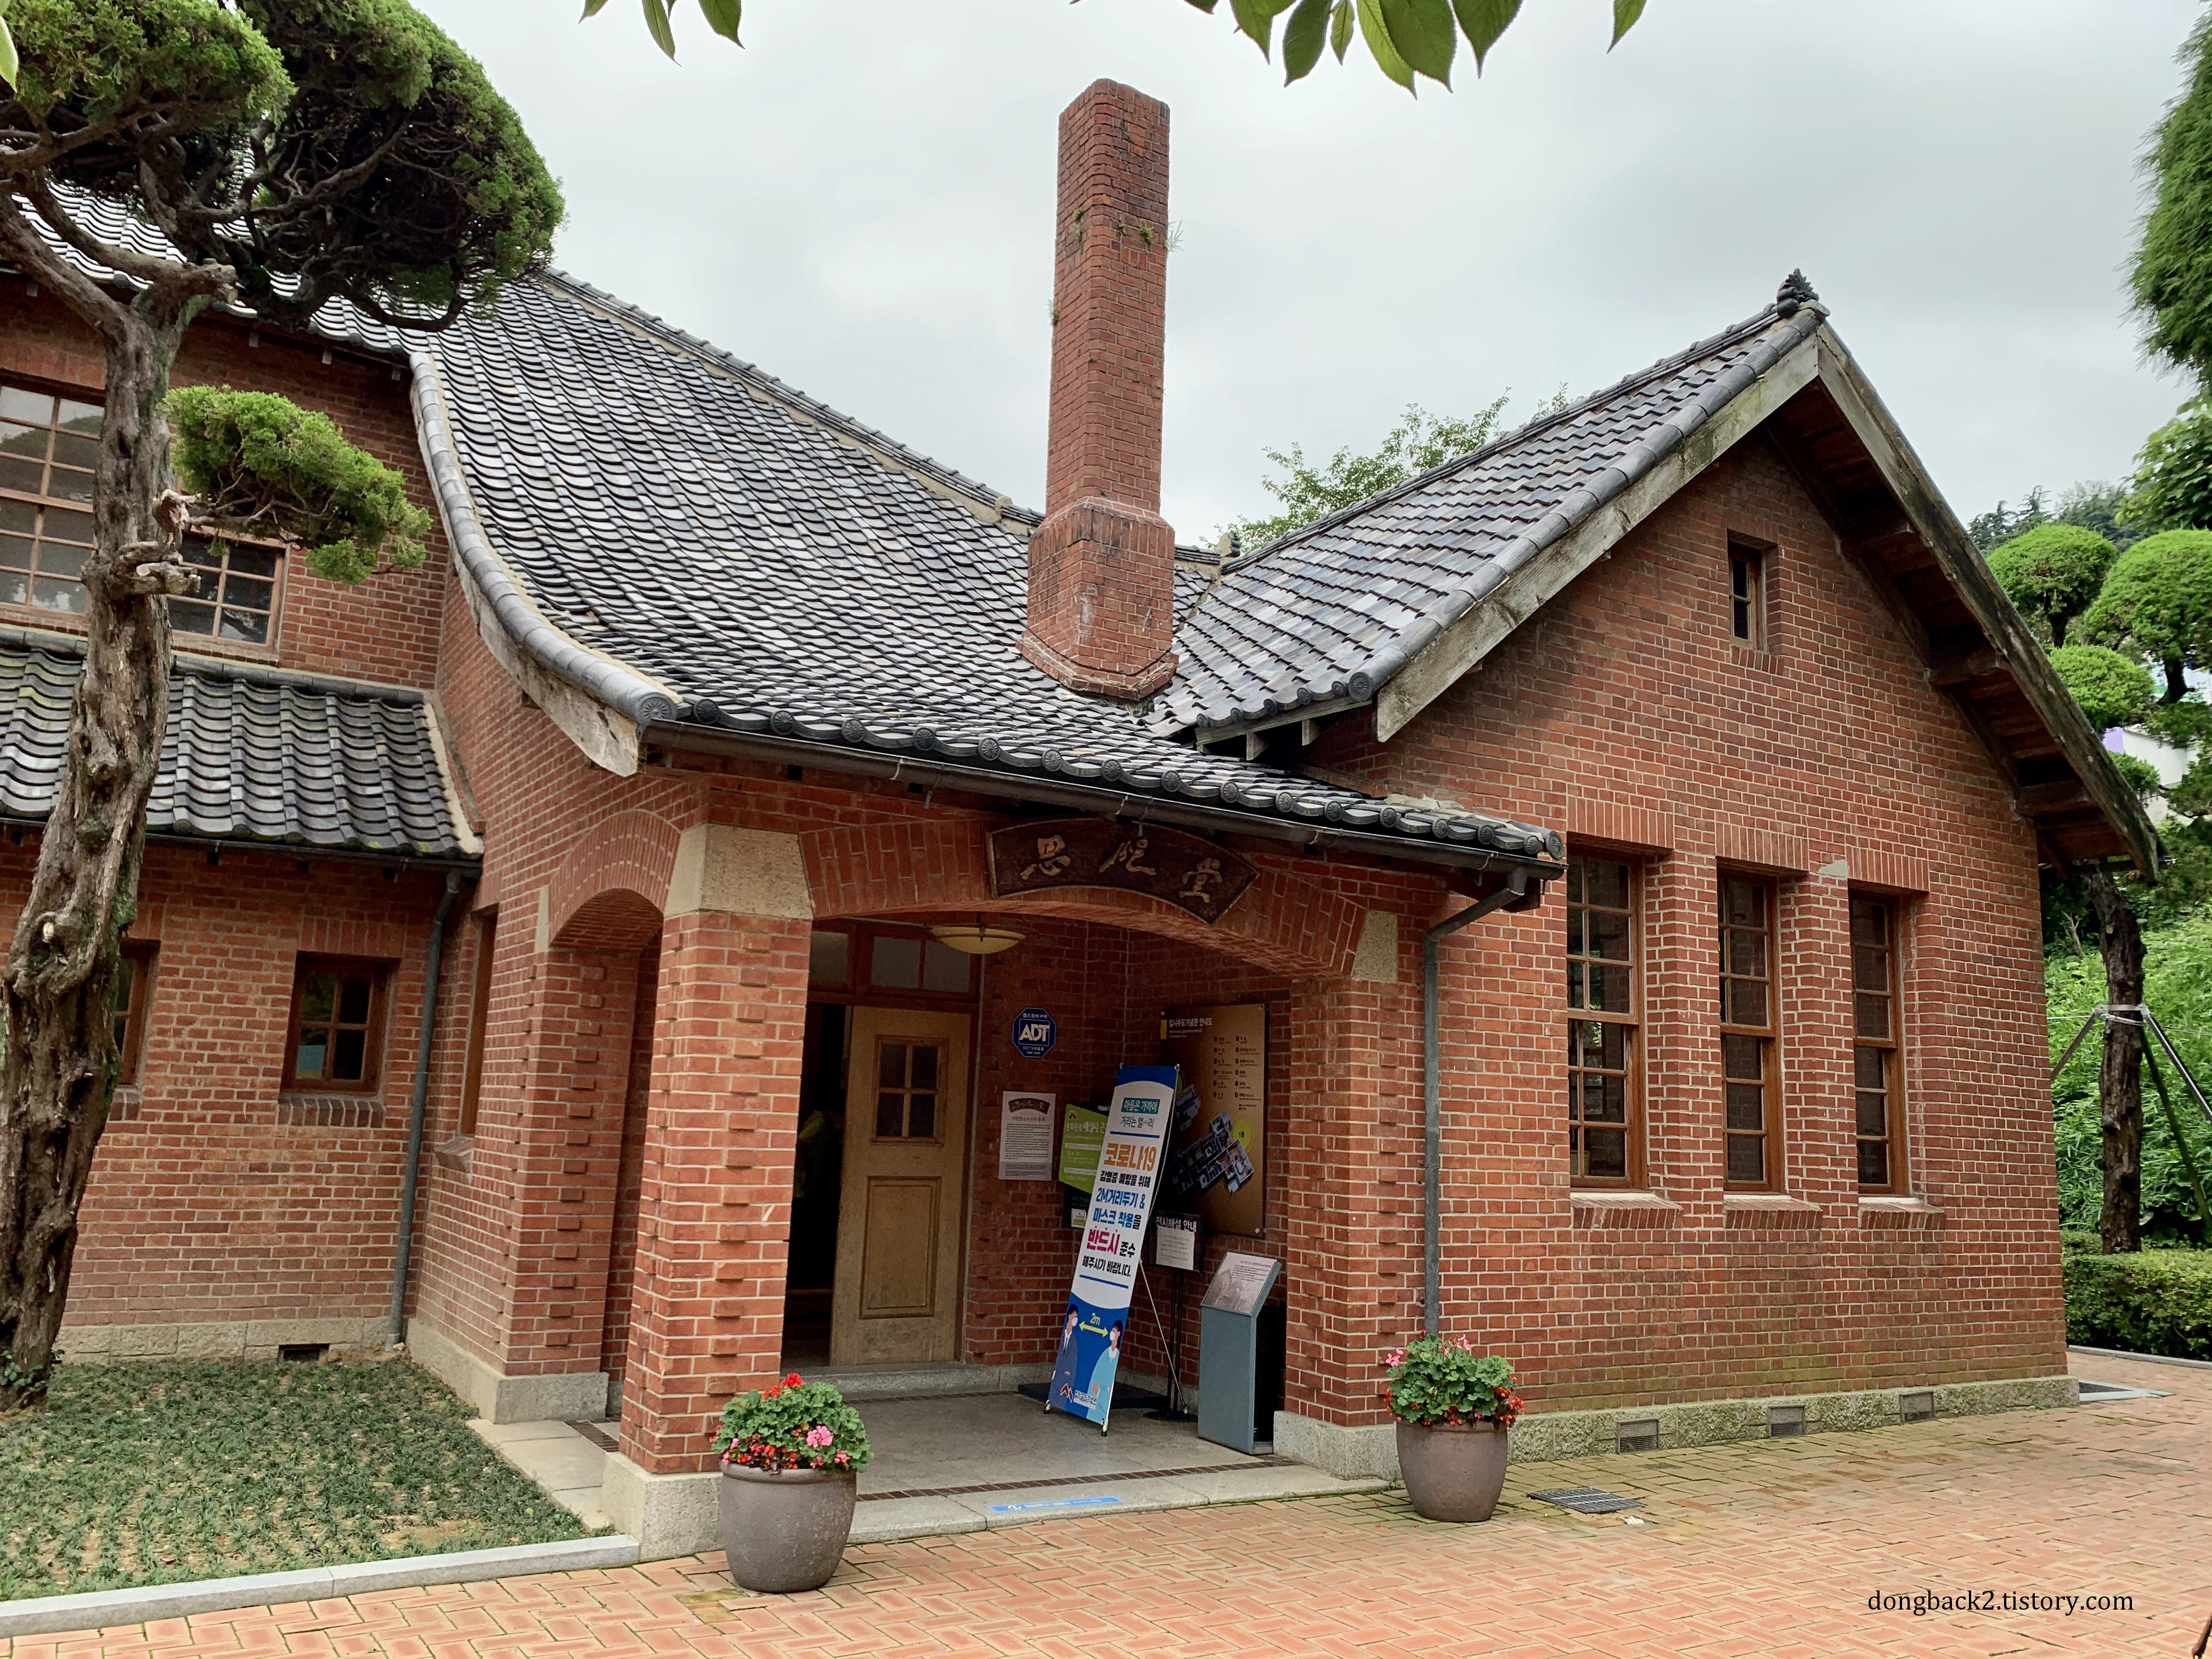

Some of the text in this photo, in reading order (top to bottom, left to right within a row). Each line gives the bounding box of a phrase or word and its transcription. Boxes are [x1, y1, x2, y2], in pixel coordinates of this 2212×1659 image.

[1169, 1018, 1212, 1027] 임시수도기념관 안내도
[1019, 1024, 1049, 1042] ADT
[1124, 1100, 1141, 1111] 마음은
[1141, 1101, 1158, 1112] 가까이
[1120, 1115, 1137, 1127] 거리는
[1103, 1142, 1157, 1171] 코로나19
[1100, 1170, 1118, 1183] 감염증
[1119, 1173, 1137, 1186] 예방을
[1138, 1176, 1152, 1188] 위해
[1096, 1187, 1139, 1208] 2M거리두기
[1139, 1193, 1146, 1210] &
[1092, 1207, 1117, 1224] 마스크
[1118, 1211, 1142, 1230] 착용을
[1155, 1216, 1197, 1233] 전시해설 안내
[1086, 1228, 1120, 1255] 반드시
[1119, 1241, 1136, 1259] 준수
[1082, 1255, 1131, 1277] 해주시기 바랍니다.
[1090, 1312, 1101, 1325] 2m
